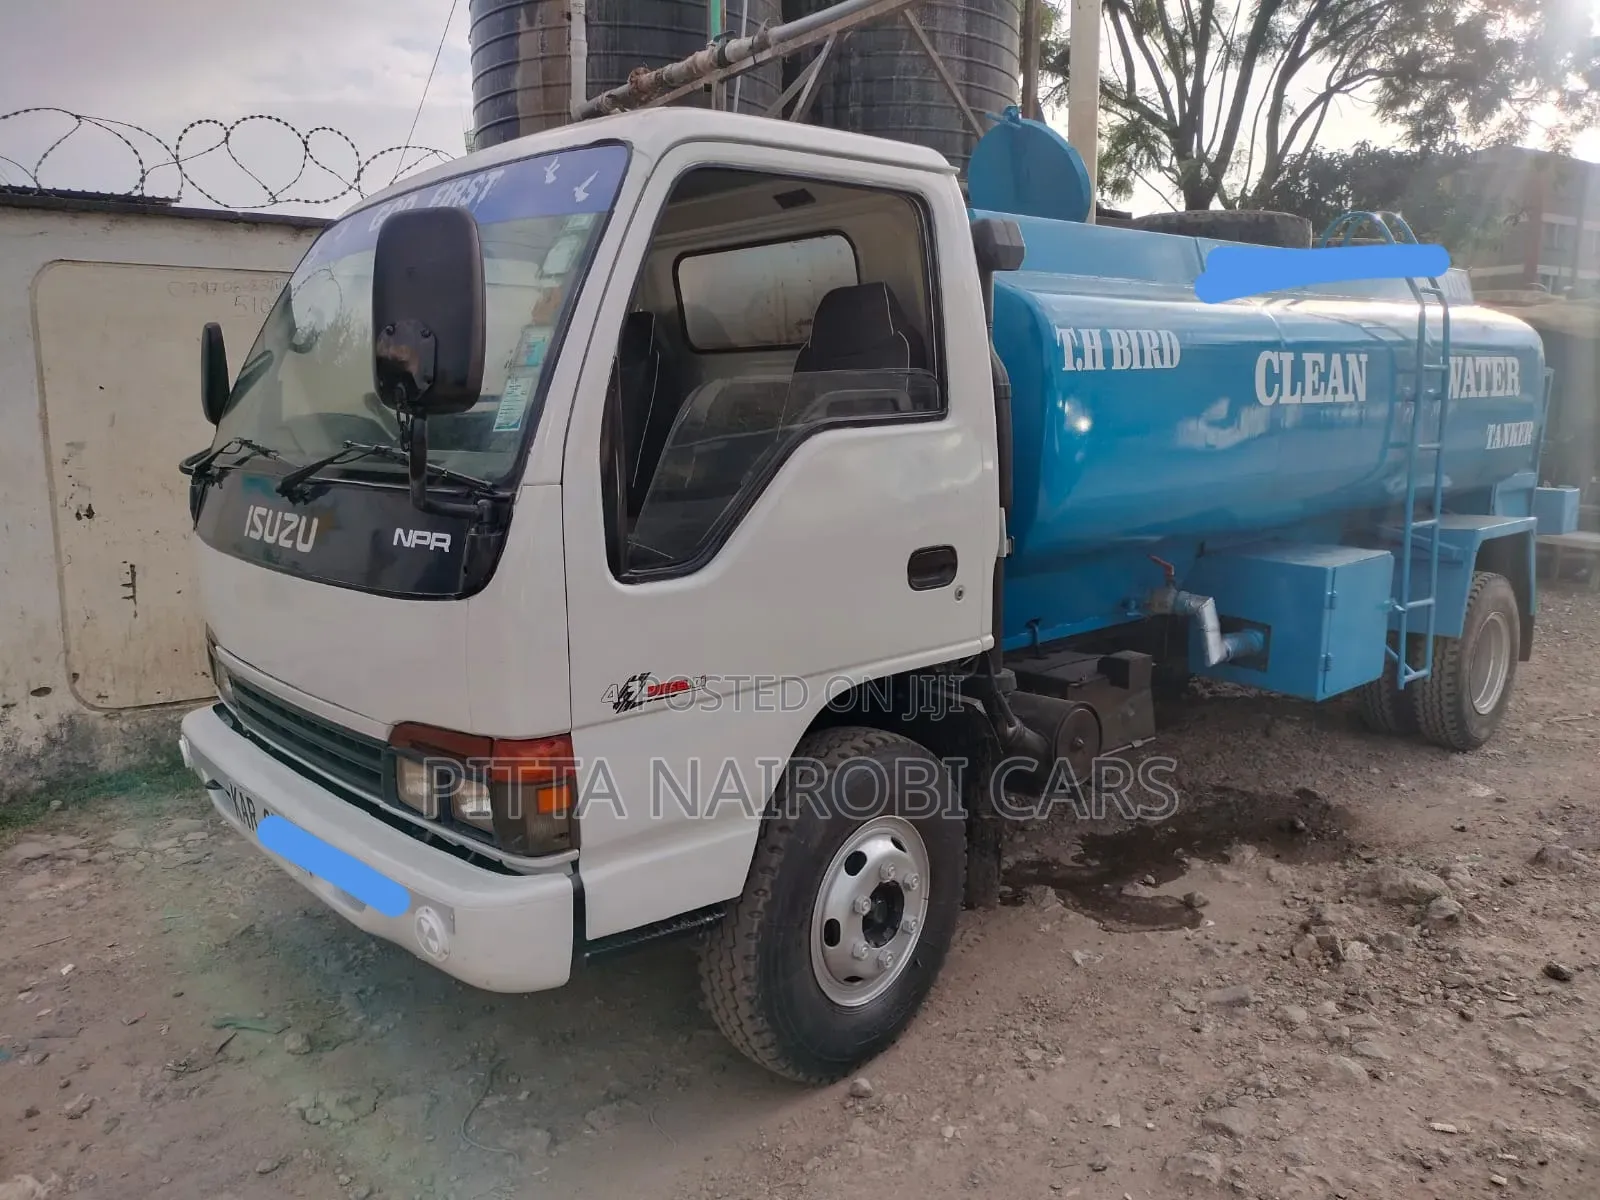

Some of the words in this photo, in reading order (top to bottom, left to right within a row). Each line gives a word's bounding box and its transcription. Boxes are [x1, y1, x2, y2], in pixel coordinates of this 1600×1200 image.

[428, 169, 505, 211] FIRST
[1056, 326, 1106, 371] T.H
[1107, 329, 1180, 370] BIRD
[1255, 350, 1368, 406] CLEAN
[1485, 421, 1533, 450] TANKER
[244, 504, 319, 553] ISUZU
[392, 527, 452, 553] NPR
